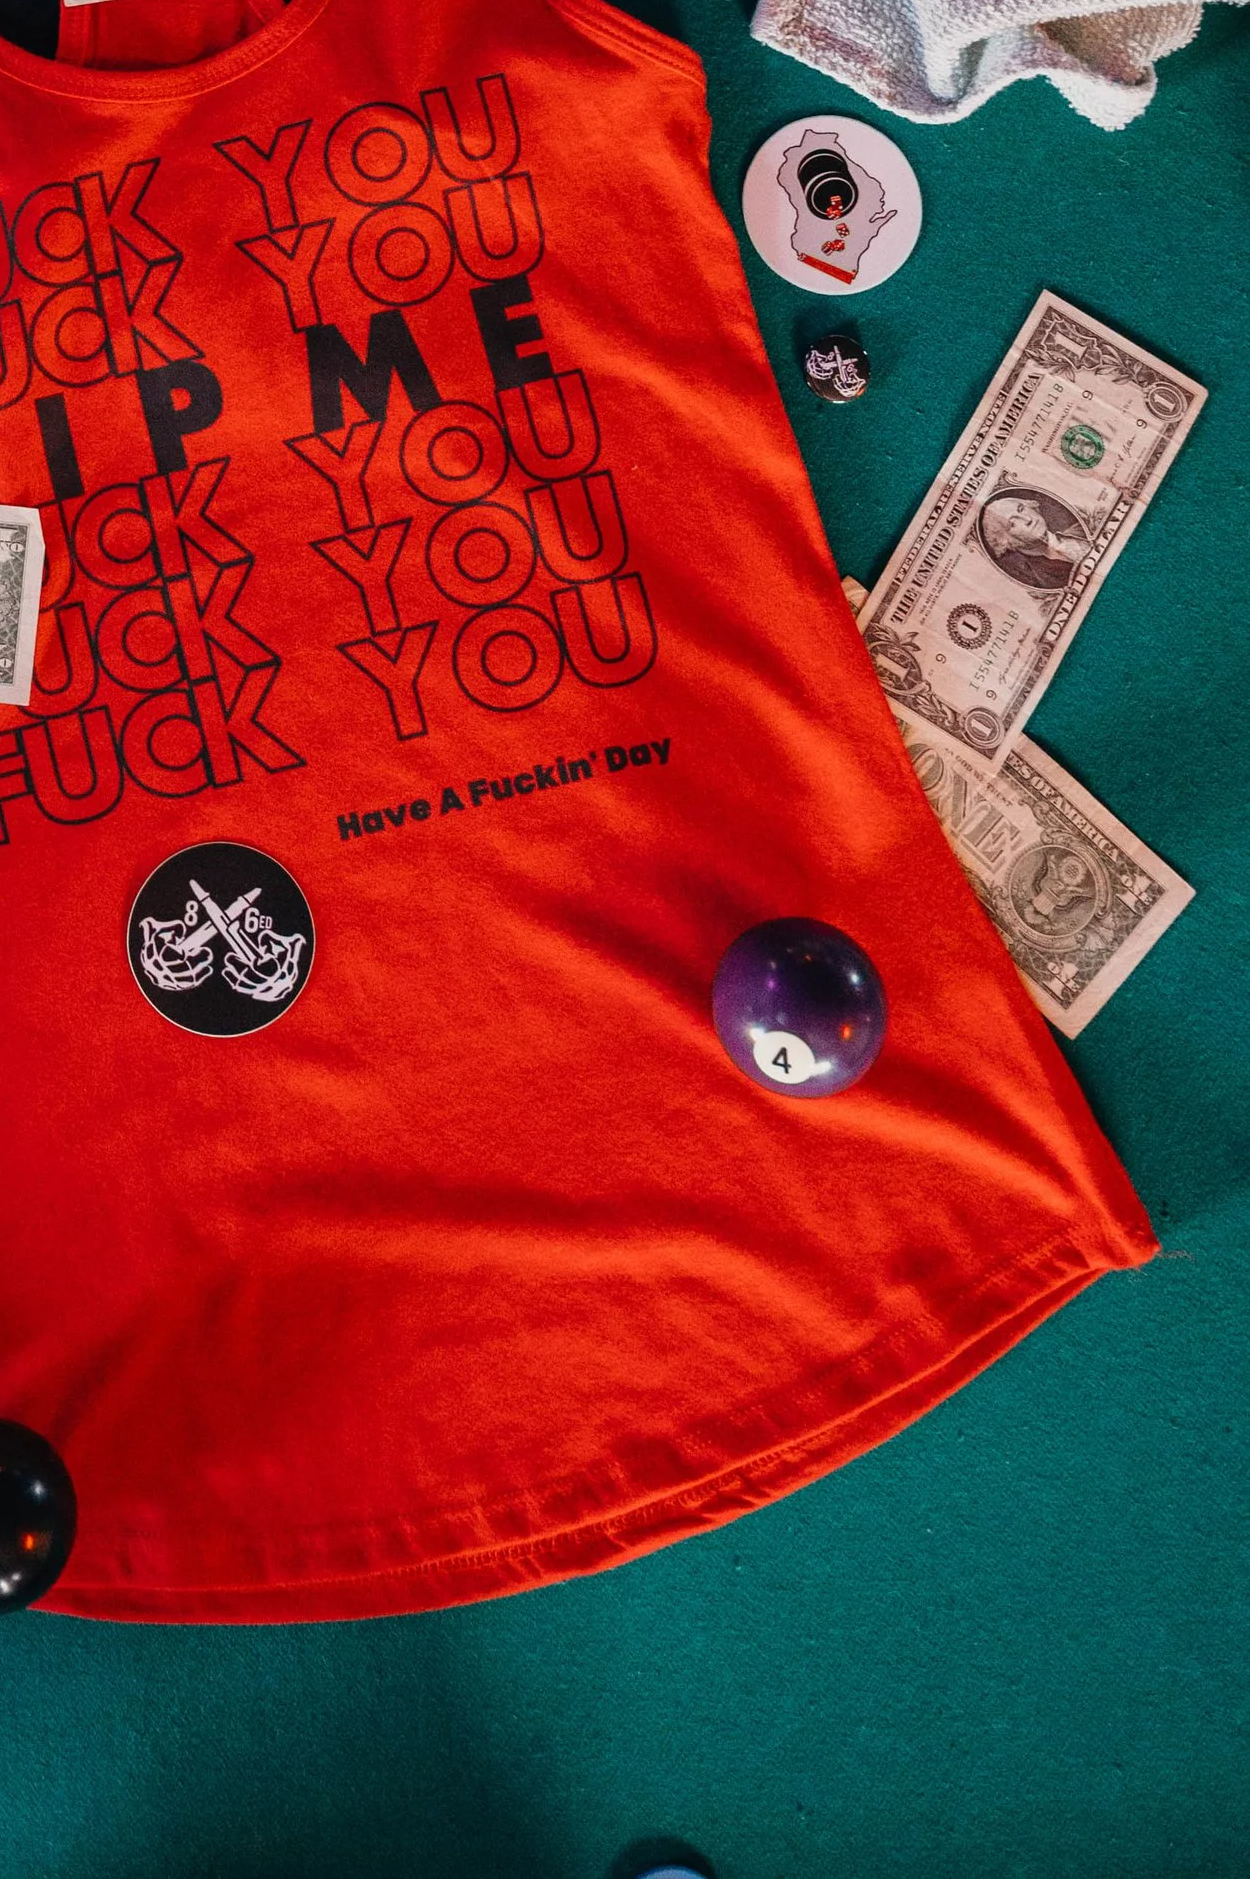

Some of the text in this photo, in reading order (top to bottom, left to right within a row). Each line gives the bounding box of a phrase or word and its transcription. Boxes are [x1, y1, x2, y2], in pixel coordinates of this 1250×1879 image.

[213, 73, 524, 231] YOU
[237, 171, 545, 330] YOU
[304, 275, 552, 432] ME
[283, 368, 603, 525] YOU
[890, 587, 922, 624] THE
[913, 526, 955, 594] UNITED
[947, 465, 990, 530] STATES
[980, 442, 1002, 469] OF
[998, 372, 1045, 452] AMERICA
[313, 470, 632, 637] YOU
[1048, 500, 1131, 642] ONE DOLLAR
[339, 570, 660, 742] YOU
[336, 737, 673, 842] Have A Fuckin' Day
[1048, 792, 1120, 864] AMERICA
[184, 900, 199, 927] 8
[771, 1046, 792, 1075] 4
